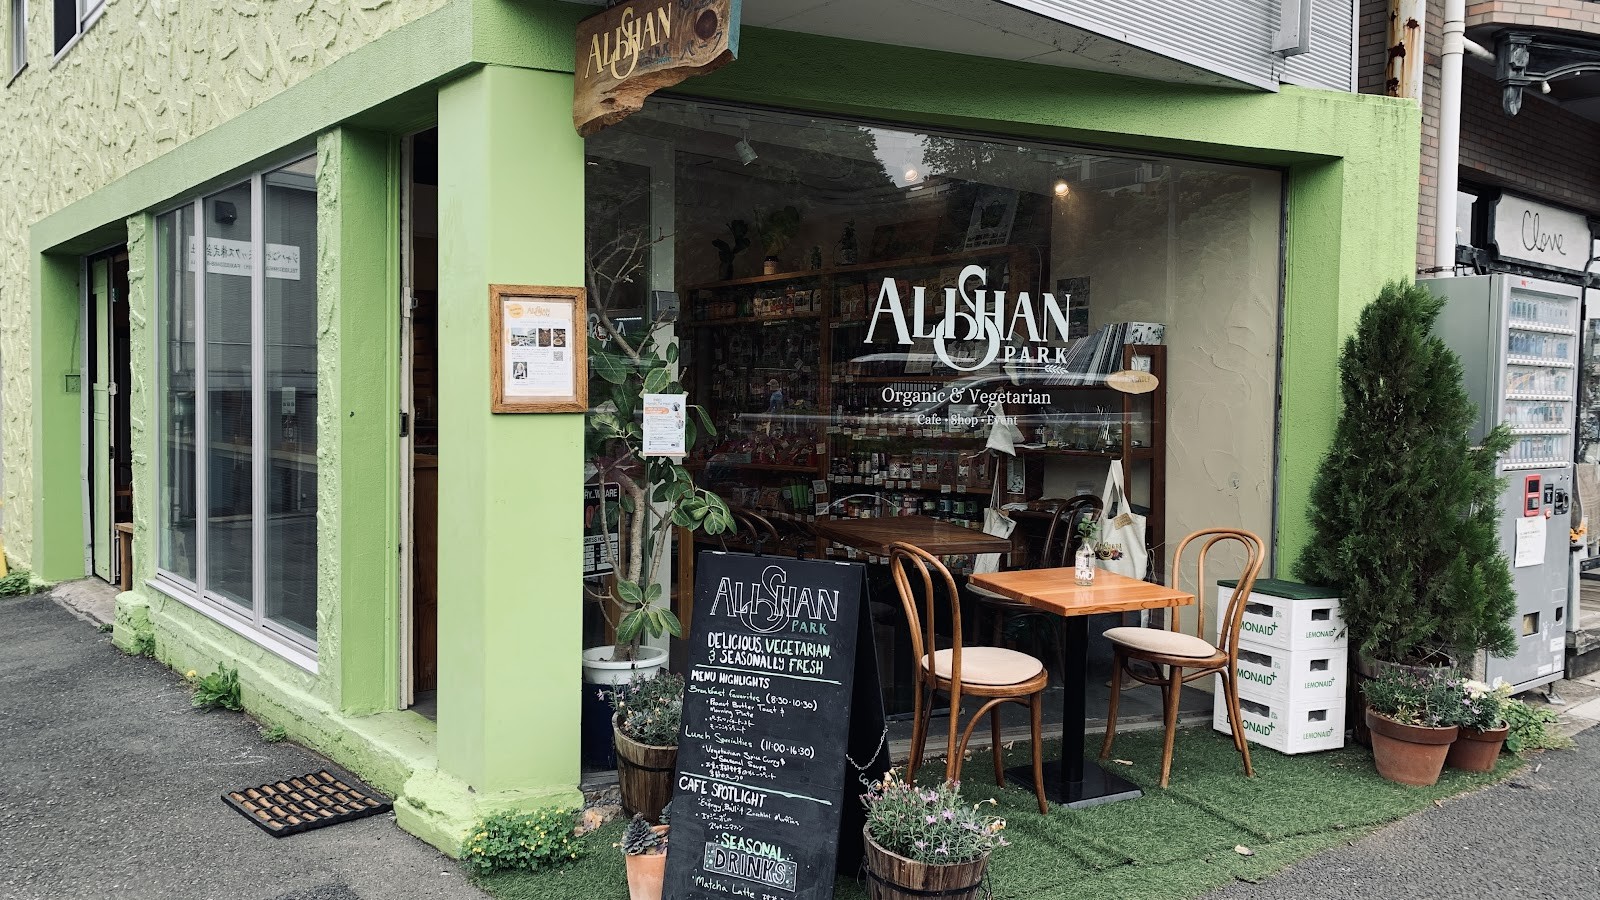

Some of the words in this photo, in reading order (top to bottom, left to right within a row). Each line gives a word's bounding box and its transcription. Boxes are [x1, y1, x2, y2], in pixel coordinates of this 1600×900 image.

[585, 2, 671, 80] ALISHAN
[864, 264, 1071, 371] ALISHAN
[1003, 346, 1068, 364] PARK
[881, 387, 946, 406] Organic
[949, 387, 965, 403] &
[969, 388, 1051, 407] Vegetarian
[917, 414, 942, 425] Cafe
[950, 415, 978, 428] Shop
[987, 414, 1018, 426] Event
[710, 565, 839, 633] ALISHAN
[791, 619, 828, 635] PARK
[719, 650, 785, 671] SEASONALLY
[789, 658, 824, 675] FRESH
[688, 685, 725, 697] Breakfast
[691, 670, 716, 682] MENU
[719, 673, 771, 689] HIGHLIGHTS
[709, 698, 730, 708] Peanut
[732, 701, 755, 711] Butter
[757, 704, 777, 714] Toast
[709, 707, 733, 719] Morning
[736, 709, 754, 719] Plate
[685, 725, 711, 740] Lunch
[714, 733, 753, 748] Specialties
[705, 745, 741, 760] Vegetarian
[743, 751, 761, 762] Spice
[762, 755, 780, 768] Curry
[718, 756, 743, 767] Seasonal
[679, 776, 708, 795] CAFE
[711, 783, 767, 807] SPOTLIGHT
[721, 832, 786, 862] SEASONAL
[714, 848, 786, 885] DRINKS
[695, 875, 728, 893] Matcha
[731, 884, 755, 899] Latte
